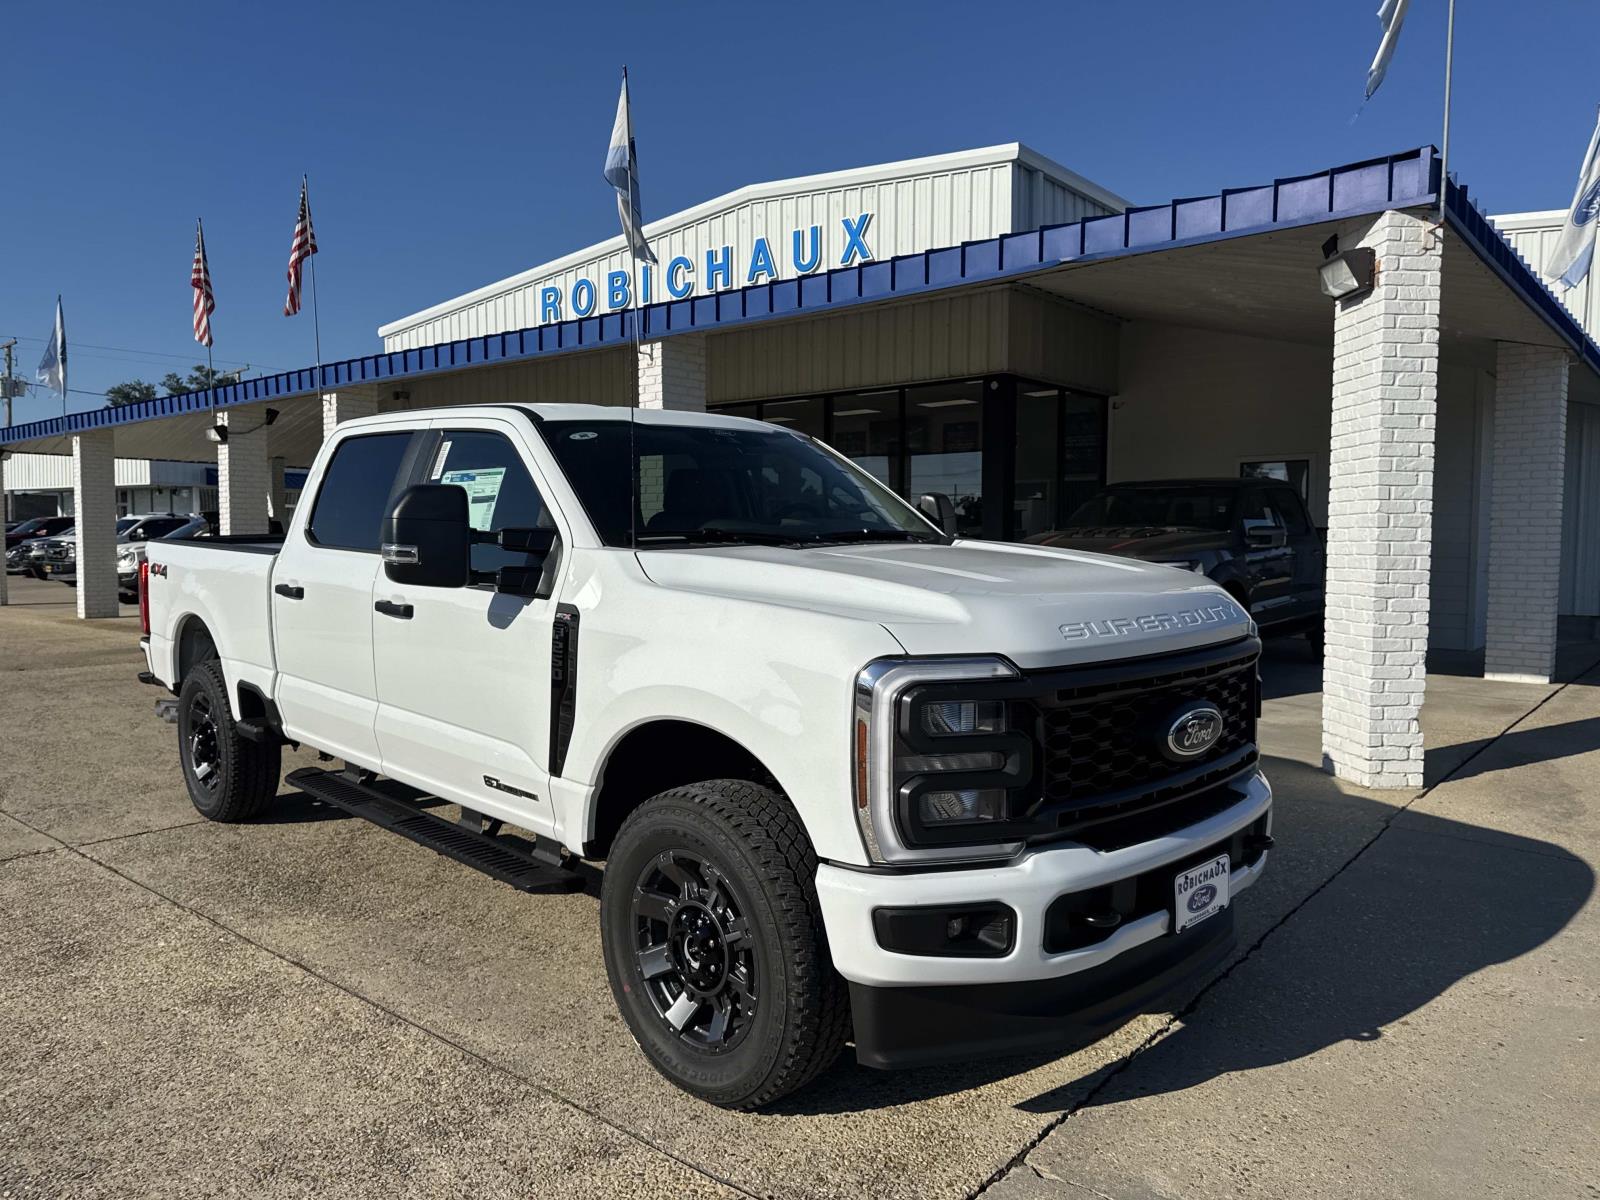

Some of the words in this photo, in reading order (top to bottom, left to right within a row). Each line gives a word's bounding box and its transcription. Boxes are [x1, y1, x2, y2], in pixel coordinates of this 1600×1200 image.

[541, 212, 874, 323] ROBICHAUX
[1184, 719, 1214, 747] Ford
[1177, 861, 1227, 896] ROBICHAUX
[1192, 889, 1211, 909] Ford
